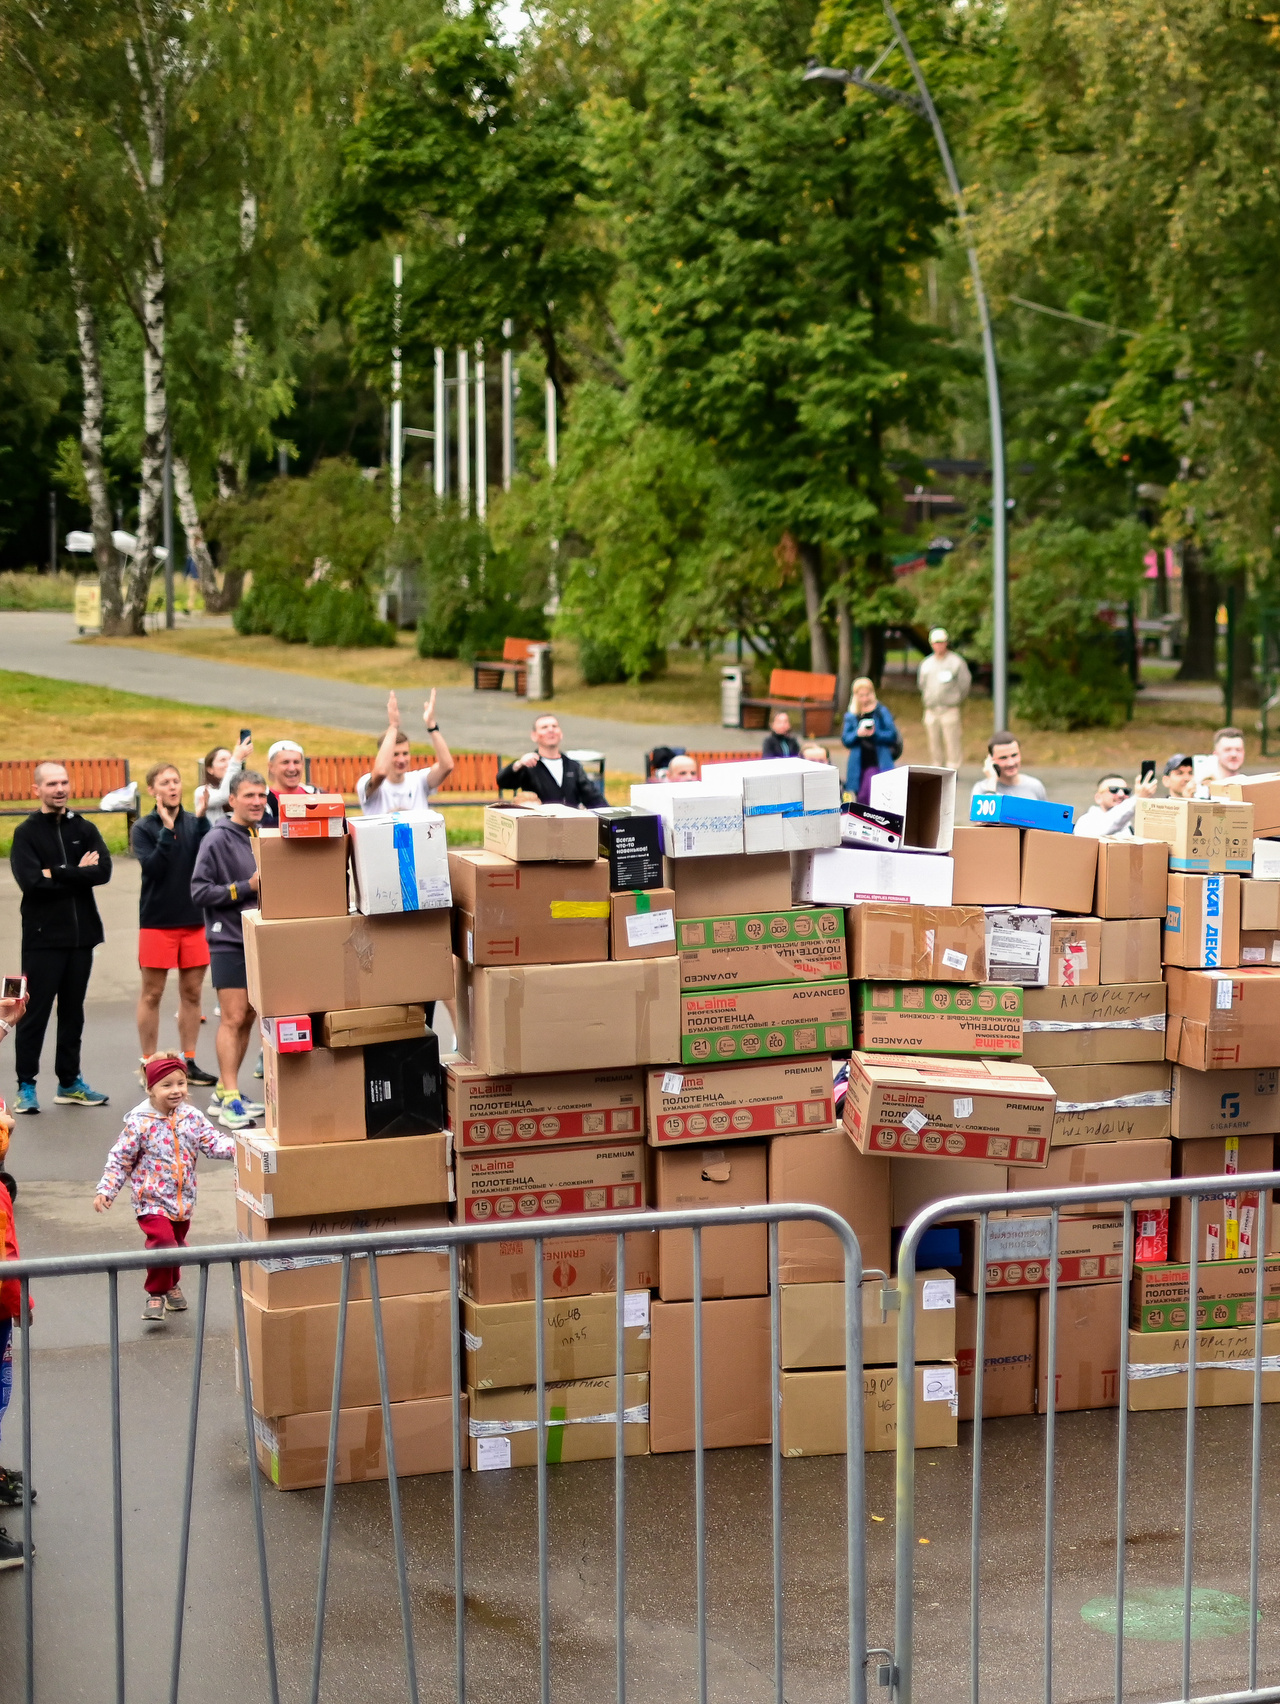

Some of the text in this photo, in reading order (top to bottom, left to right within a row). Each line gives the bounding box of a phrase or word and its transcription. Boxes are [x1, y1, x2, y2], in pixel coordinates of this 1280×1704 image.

[616, 836, 636, 844] Всегда
[616, 846, 648, 854] новенькое!
[747, 924, 761, 932] ECO
[771, 926, 787, 934] 200
[1205, 924, 1218, 966] ДЕКА
[684, 972, 738, 983] ADVANCED
[792, 988, 846, 1000] ADVANCED
[934, 994, 948, 1002] ECO
[698, 996, 737, 1010] Laima
[956, 998, 972, 1006] 200
[1004, 1000, 1016, 1010] 21
[688, 1014, 755, 1026] ПОЛОТЕНЦА
[688, 1024, 730, 1034] БУМАЖНЫЕ
[731, 1021, 768, 1030] ЛИСТОВЫЕ
[781, 1016, 818, 1026] СЛОЖЕНИЯ
[960, 1022, 1020, 1032] ПОЛОТЕНЦА
[694, 1040, 708, 1050] 21
[743, 1038, 760, 1046] 200
[769, 1040, 782, 1048] ECO
[872, 1037, 923, 1046] ADVANCED
[975, 1038, 1012, 1050] Laima
[784, 1066, 823, 1076] PREMIUM
[594, 1074, 634, 1084] PREMIUM
[477, 1082, 512, 1094] Laima
[662, 1093, 725, 1106] ПОЛОТЕНЦА
[891, 1093, 925, 1103] Laima
[470, 1100, 533, 1112] ПОЛОТЕНЦА
[663, 1103, 701, 1112] БУМАЖНЫЕ
[702, 1100, 736, 1108] ЛИСТОВЫЕ
[748, 1095, 784, 1103] СЛОЖЕНИЯ
[1006, 1104, 1045, 1112] PREMIUM
[470, 1108, 509, 1118] БУМАЖНЫЕ
[510, 1106, 545, 1114] ЛИСТОВЫЕ
[557, 1102, 592, 1111] СЛОЖЕНИЯ
[666, 1119, 680, 1128] 15
[712, 1115, 727, 1123] 200
[473, 1126, 486, 1134] 15
[519, 1122, 534, 1130] 200
[1210, 1122, 1249, 1130] GIGAFARM
[880, 1131, 893, 1140] 15
[925, 1136, 941, 1144] 200
[596, 1150, 635, 1159] PREMIUM
[479, 1160, 514, 1171] Laima
[471, 1177, 535, 1188] ПОЛОТЕНЦА
[471, 1185, 510, 1194] БУМАЖНЫЕ
[512, 1183, 547, 1191] ЛИСТОВЫЕ
[558, 1179, 594, 1187] СЛОЖЕНИЯ
[474, 1202, 488, 1212] 15
[520, 1199, 536, 1207] 200
[987, 1268, 999, 1277] 15
[1027, 1266, 1040, 1274] 200
[1154, 1271, 1189, 1282] Laima
[1146, 1287, 1204, 1298] ПОЛОТЕНА
[1150, 1311, 1161, 1320] 21
[1172, 1336, 1248, 1350] АЛОРИТМ
